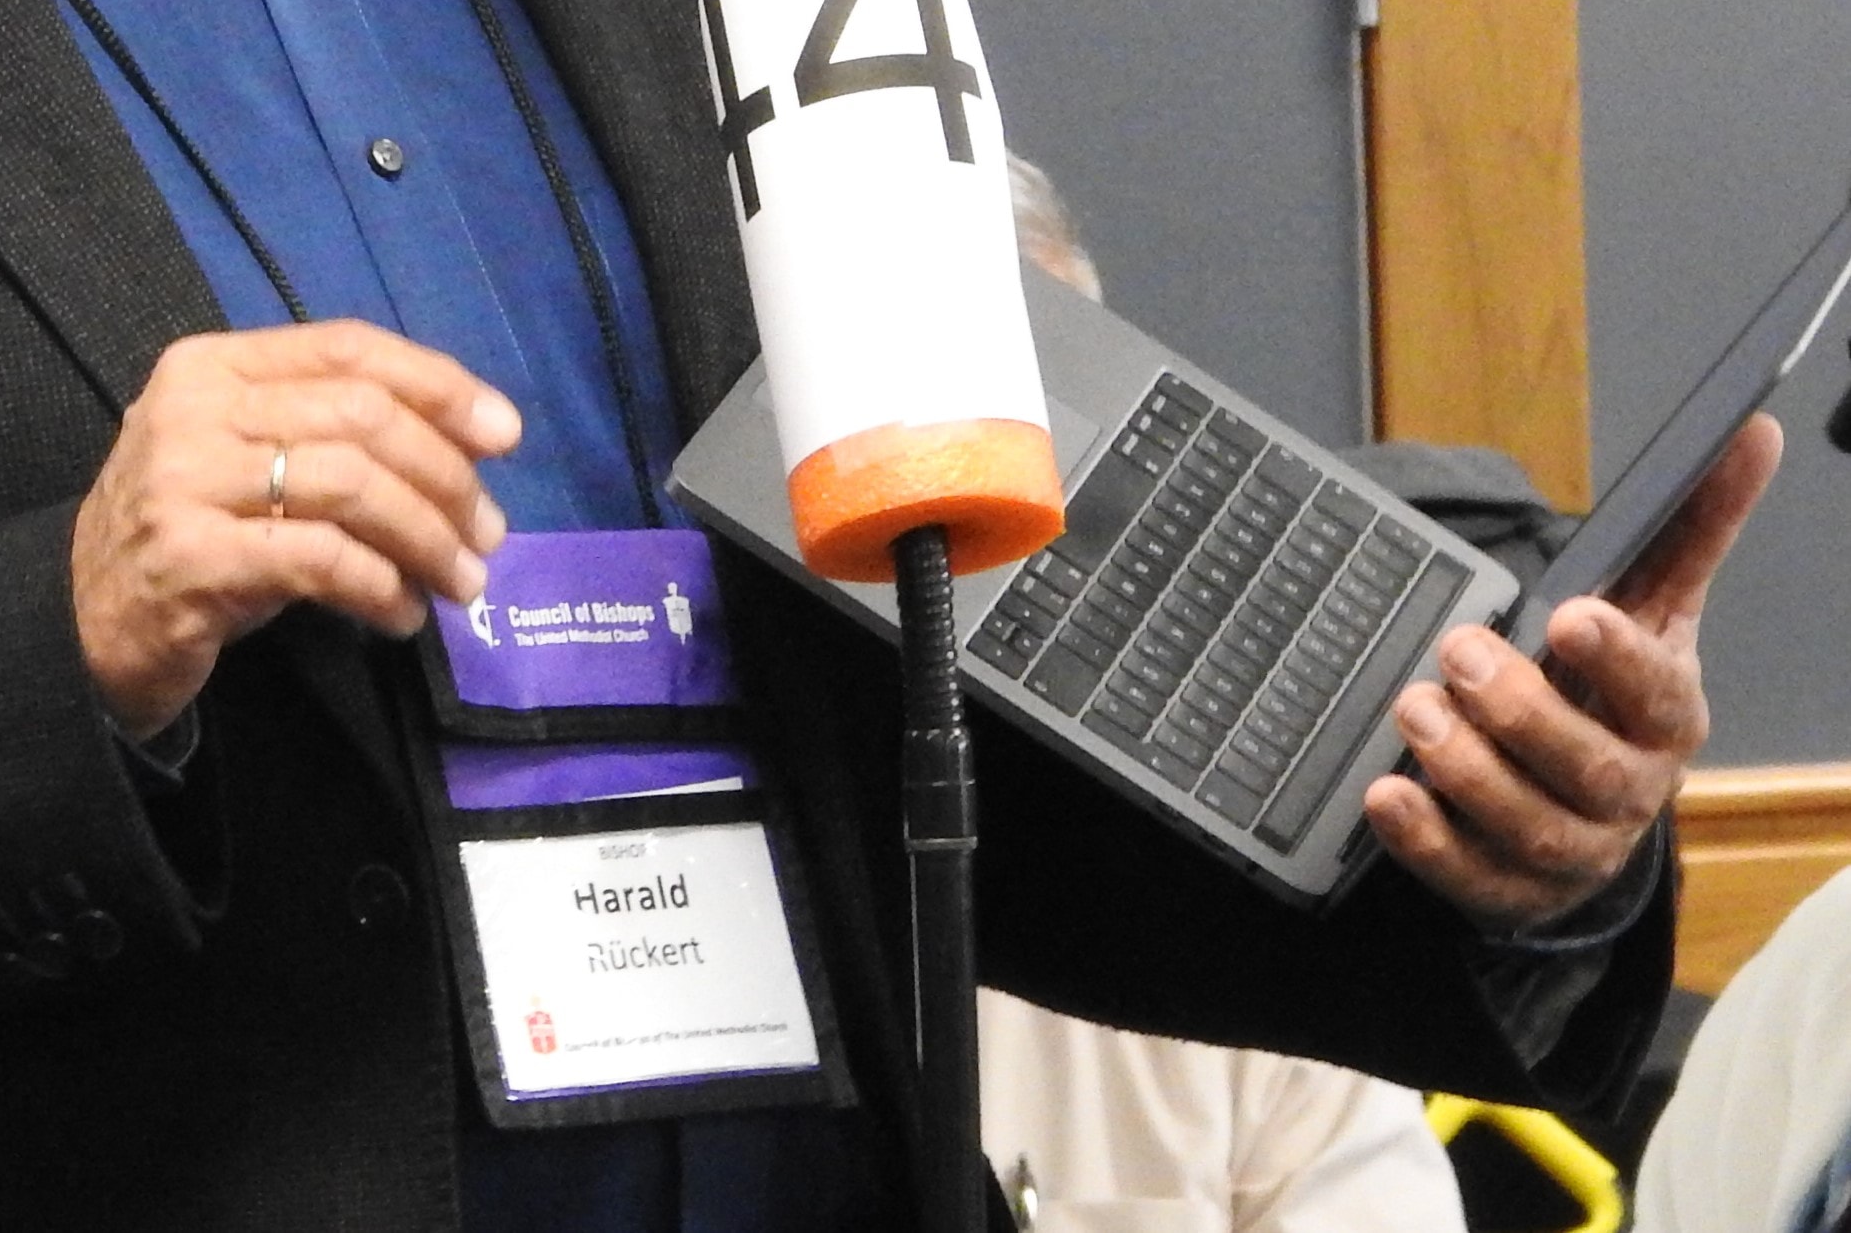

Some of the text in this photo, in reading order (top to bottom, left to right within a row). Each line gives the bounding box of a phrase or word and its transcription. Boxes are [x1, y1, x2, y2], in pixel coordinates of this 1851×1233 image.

[508, 601, 655, 628] Council of Bishops
[573, 873, 690, 914] Harald
[587, 936, 705, 973] Rückert
